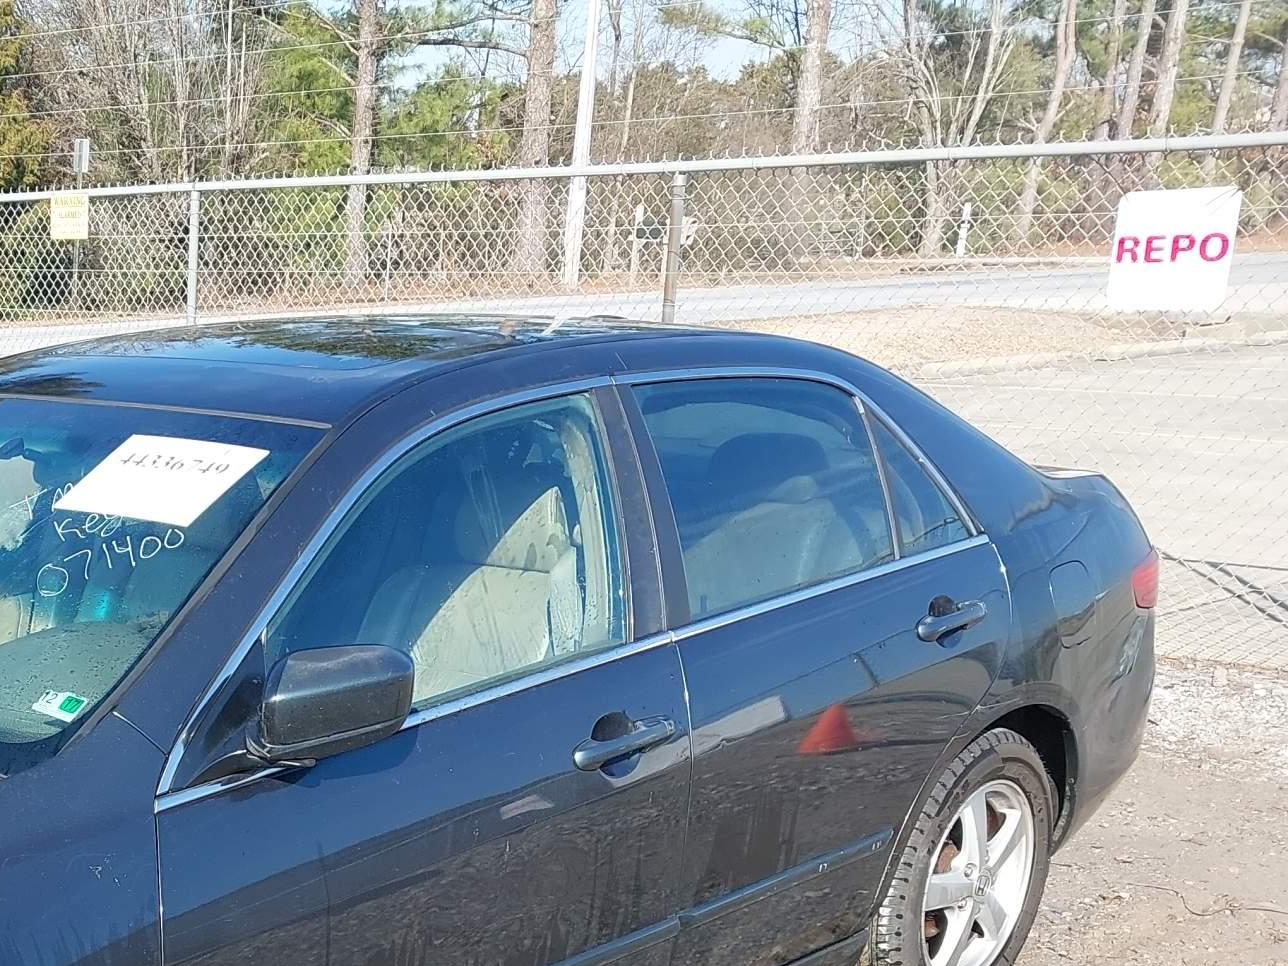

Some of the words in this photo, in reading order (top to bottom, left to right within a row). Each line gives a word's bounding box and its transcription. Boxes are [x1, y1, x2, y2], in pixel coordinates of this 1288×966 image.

[1116, 232, 1230, 264] REPO
[36, 528, 185, 596] 071400
[41, 690, 58, 704] 12
